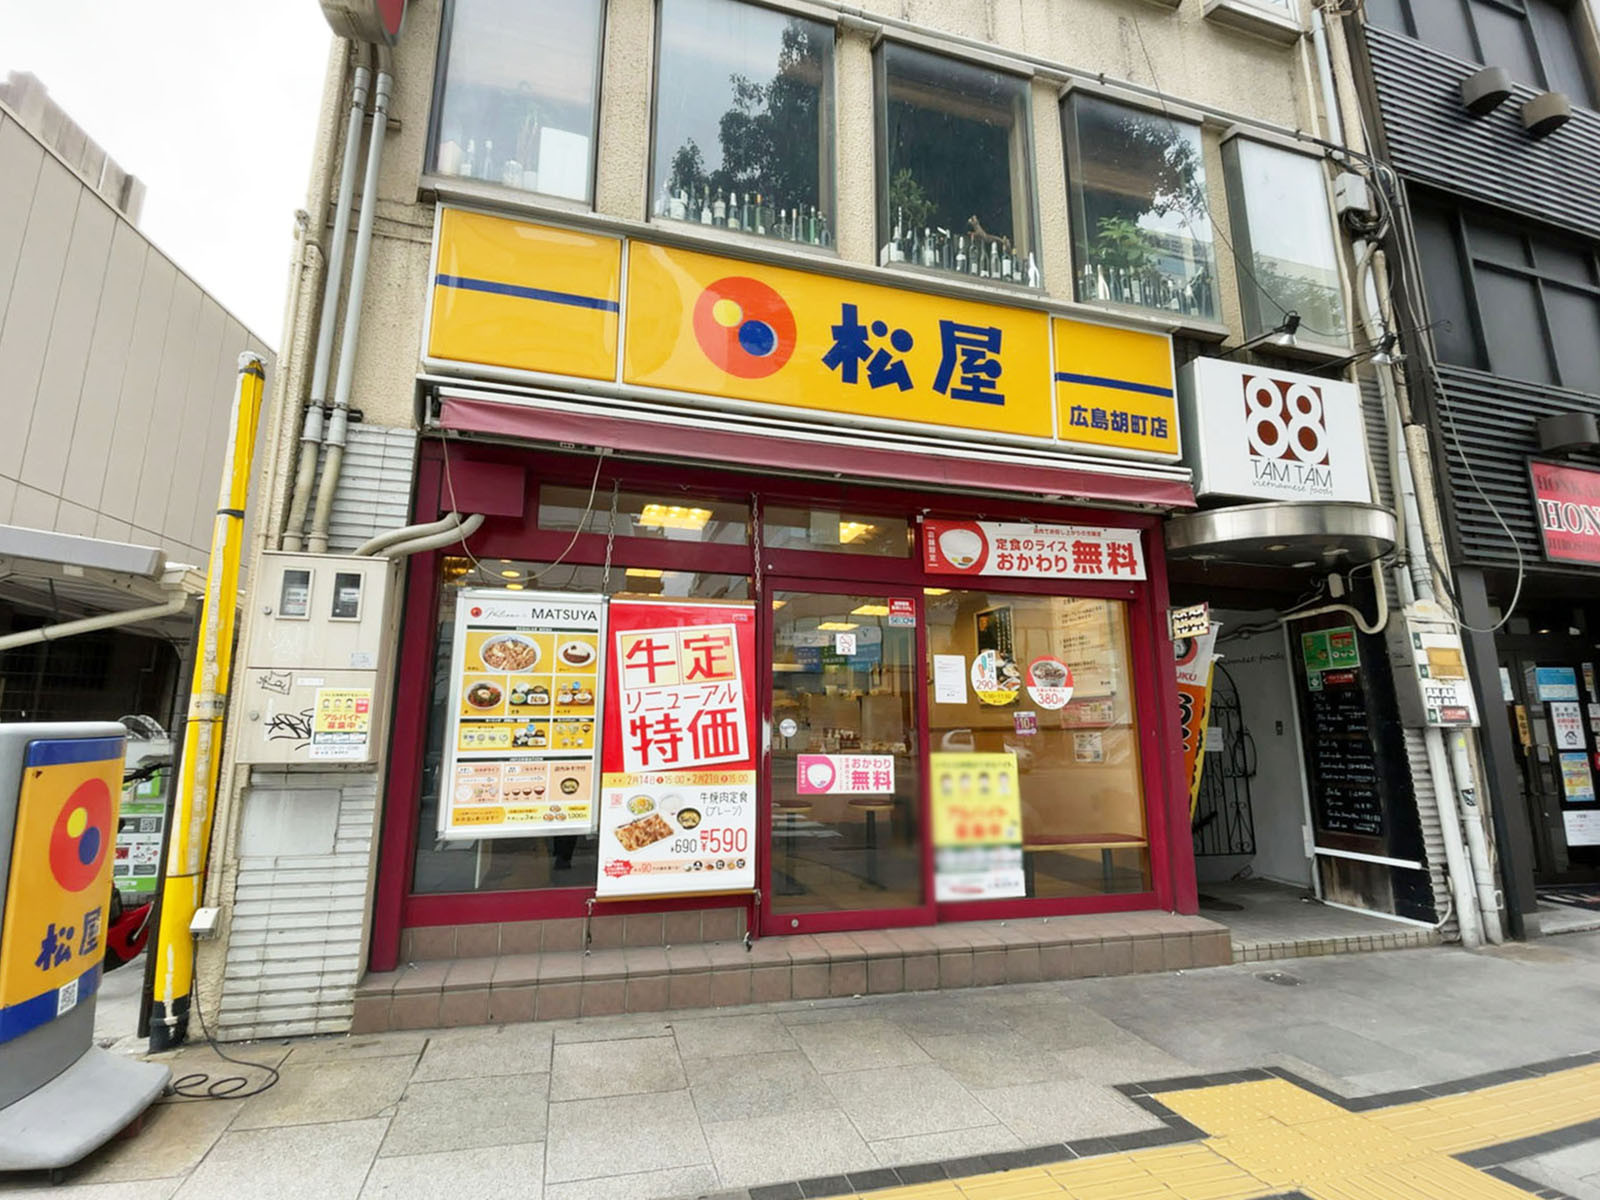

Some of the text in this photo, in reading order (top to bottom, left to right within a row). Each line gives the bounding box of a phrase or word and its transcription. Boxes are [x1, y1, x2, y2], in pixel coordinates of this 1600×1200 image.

[822, 303, 1005, 406] 松屋
[1069, 405, 1168, 438] 広島胡町店
[1245, 375, 1329, 465] 88
[996, 538, 1068, 552] 定食のライス
[1072, 540, 1138, 575] 無料
[997, 553, 1068, 572] おかわり
[531, 608, 598, 621] MATSUYA
[625, 634, 734, 684] 牛定
[626, 683, 737, 714] リニューアル
[323, 713, 361, 721] アルバイト
[629, 708, 740, 766] 特価
[851, 758, 892, 769] おかわり
[851, 769, 892, 791] 無料
[35, 907, 102, 972] 松屋
